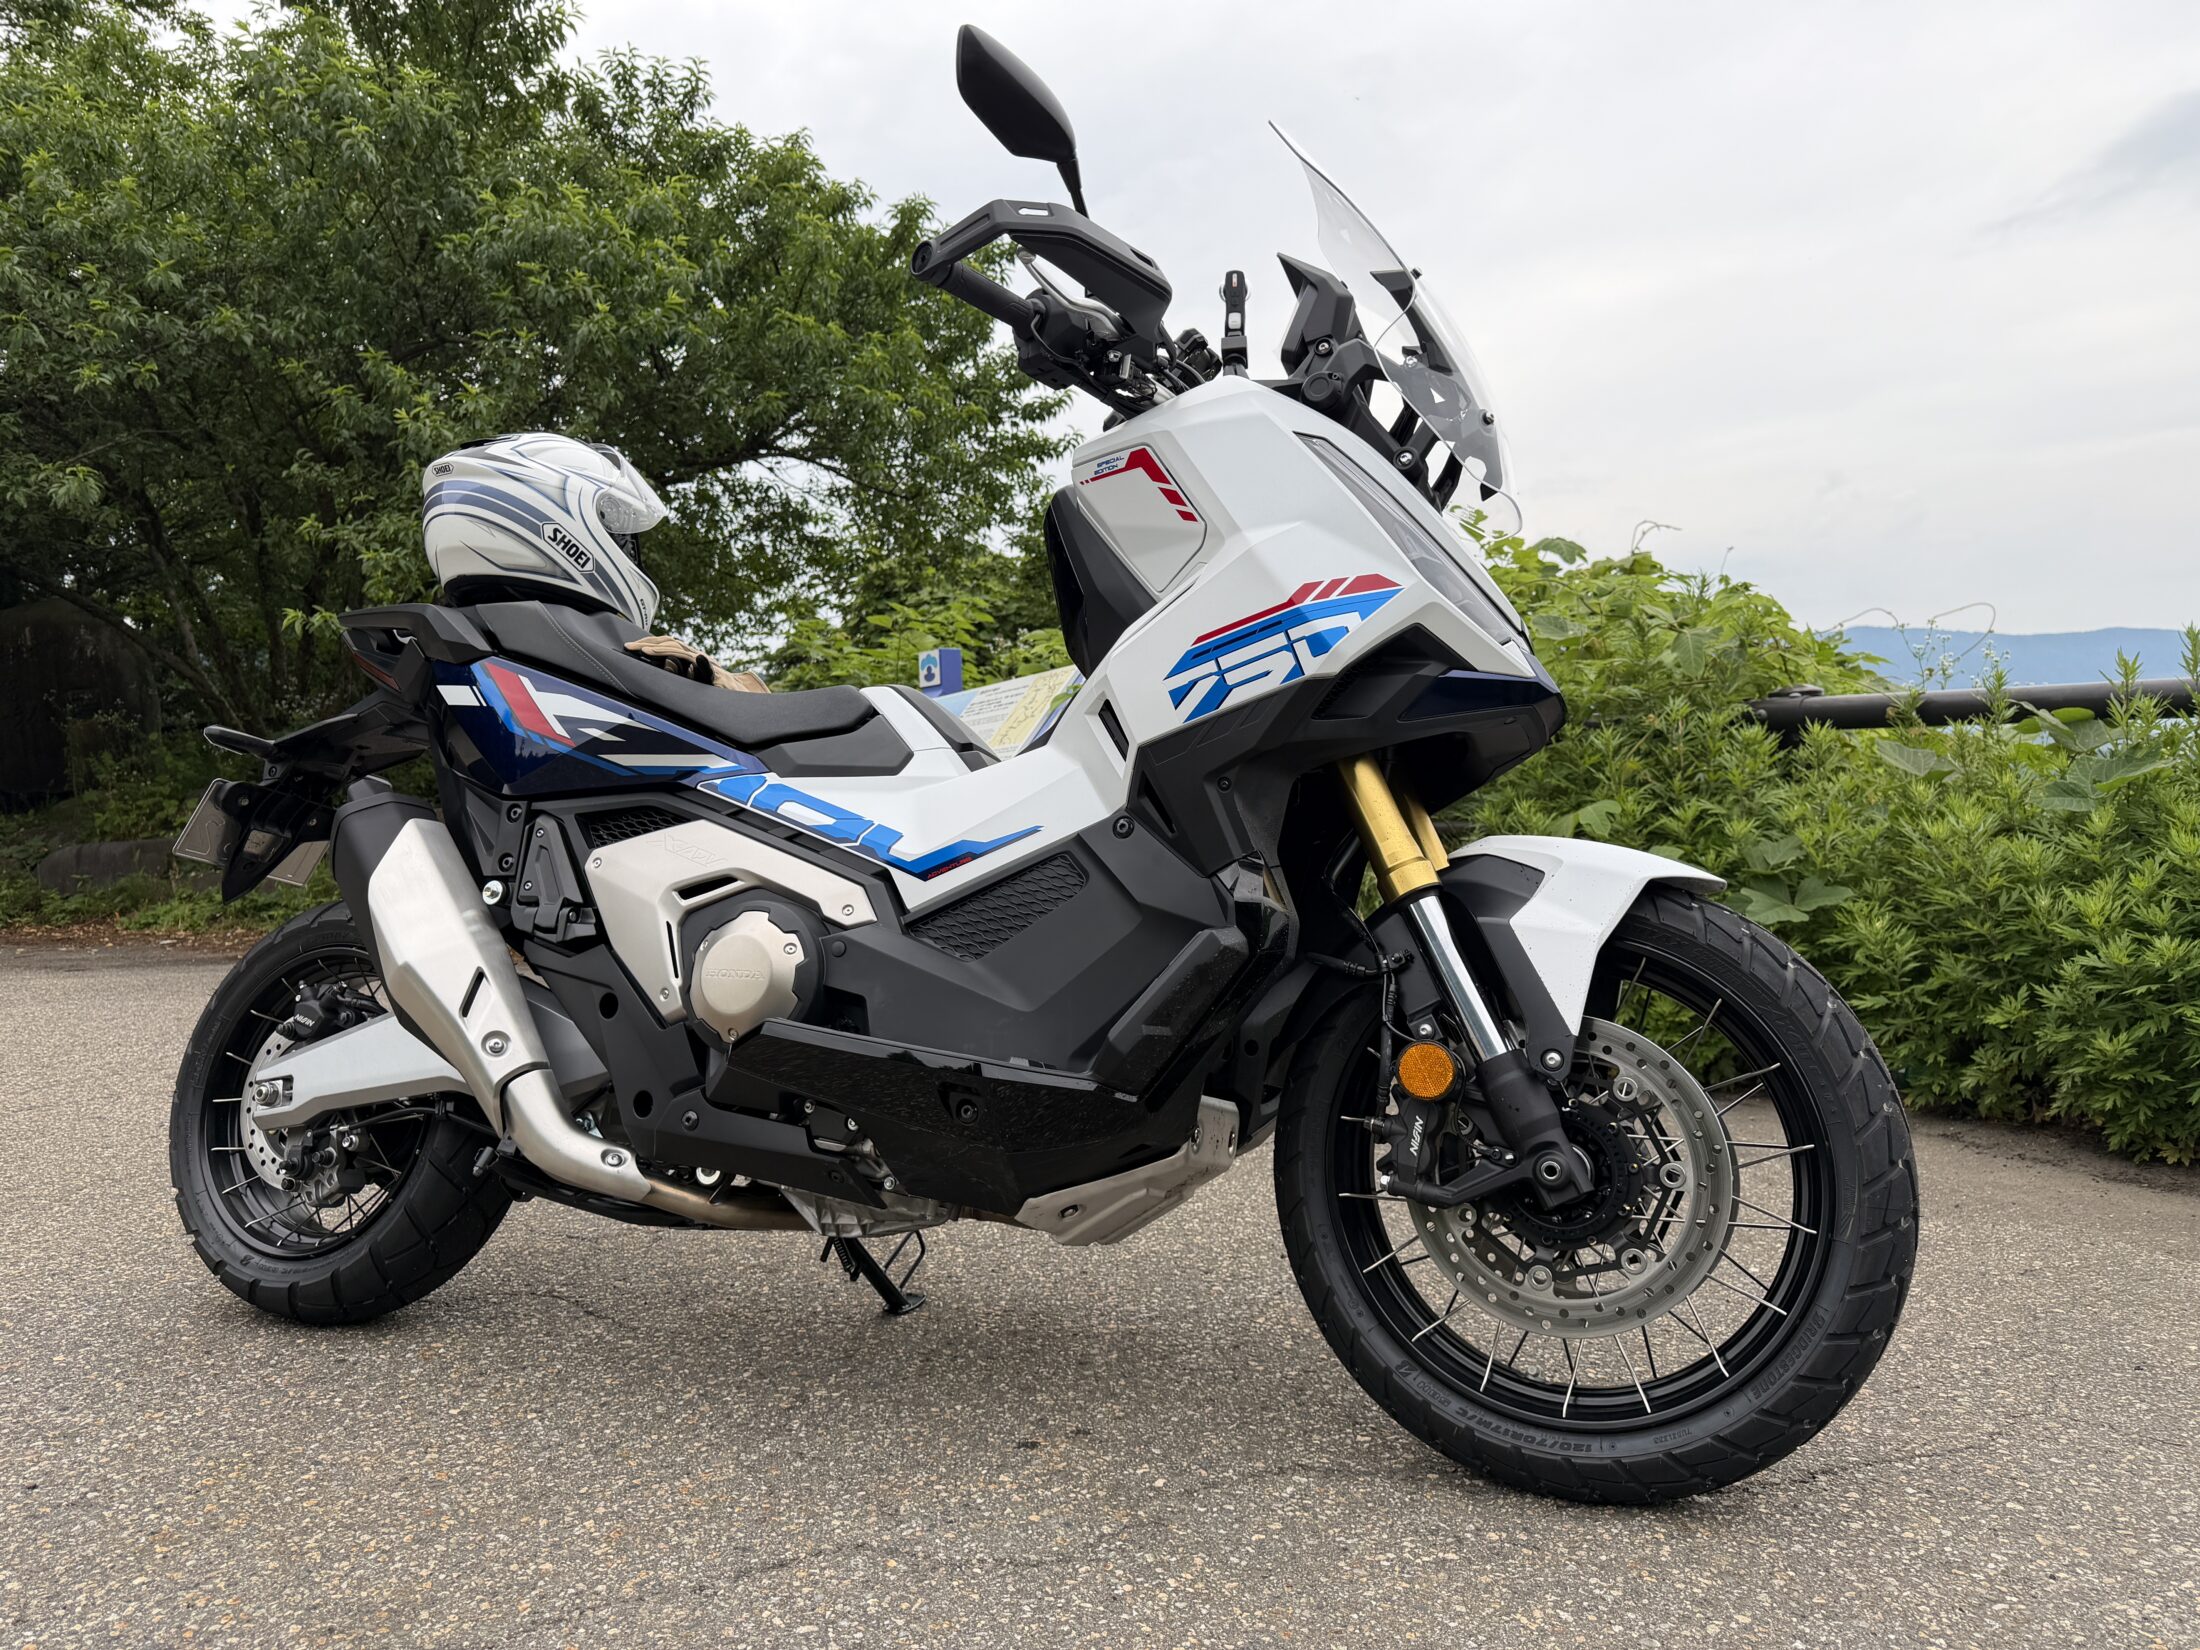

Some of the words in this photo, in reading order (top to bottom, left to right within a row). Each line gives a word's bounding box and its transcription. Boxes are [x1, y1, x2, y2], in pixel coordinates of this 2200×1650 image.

[433, 464, 452, 475] SHOEI
[1093, 463, 1119, 476] EDITION
[1096, 455, 1125, 469] SPECIAL
[547, 527, 591, 570] SHOEI
[927, 856, 973, 879] ADVENTURE
[705, 968, 766, 980] HONDA
[1410, 1115, 1424, 1157] NISSIN
[1750, 1310, 1827, 1401] BRIDGESTONE
